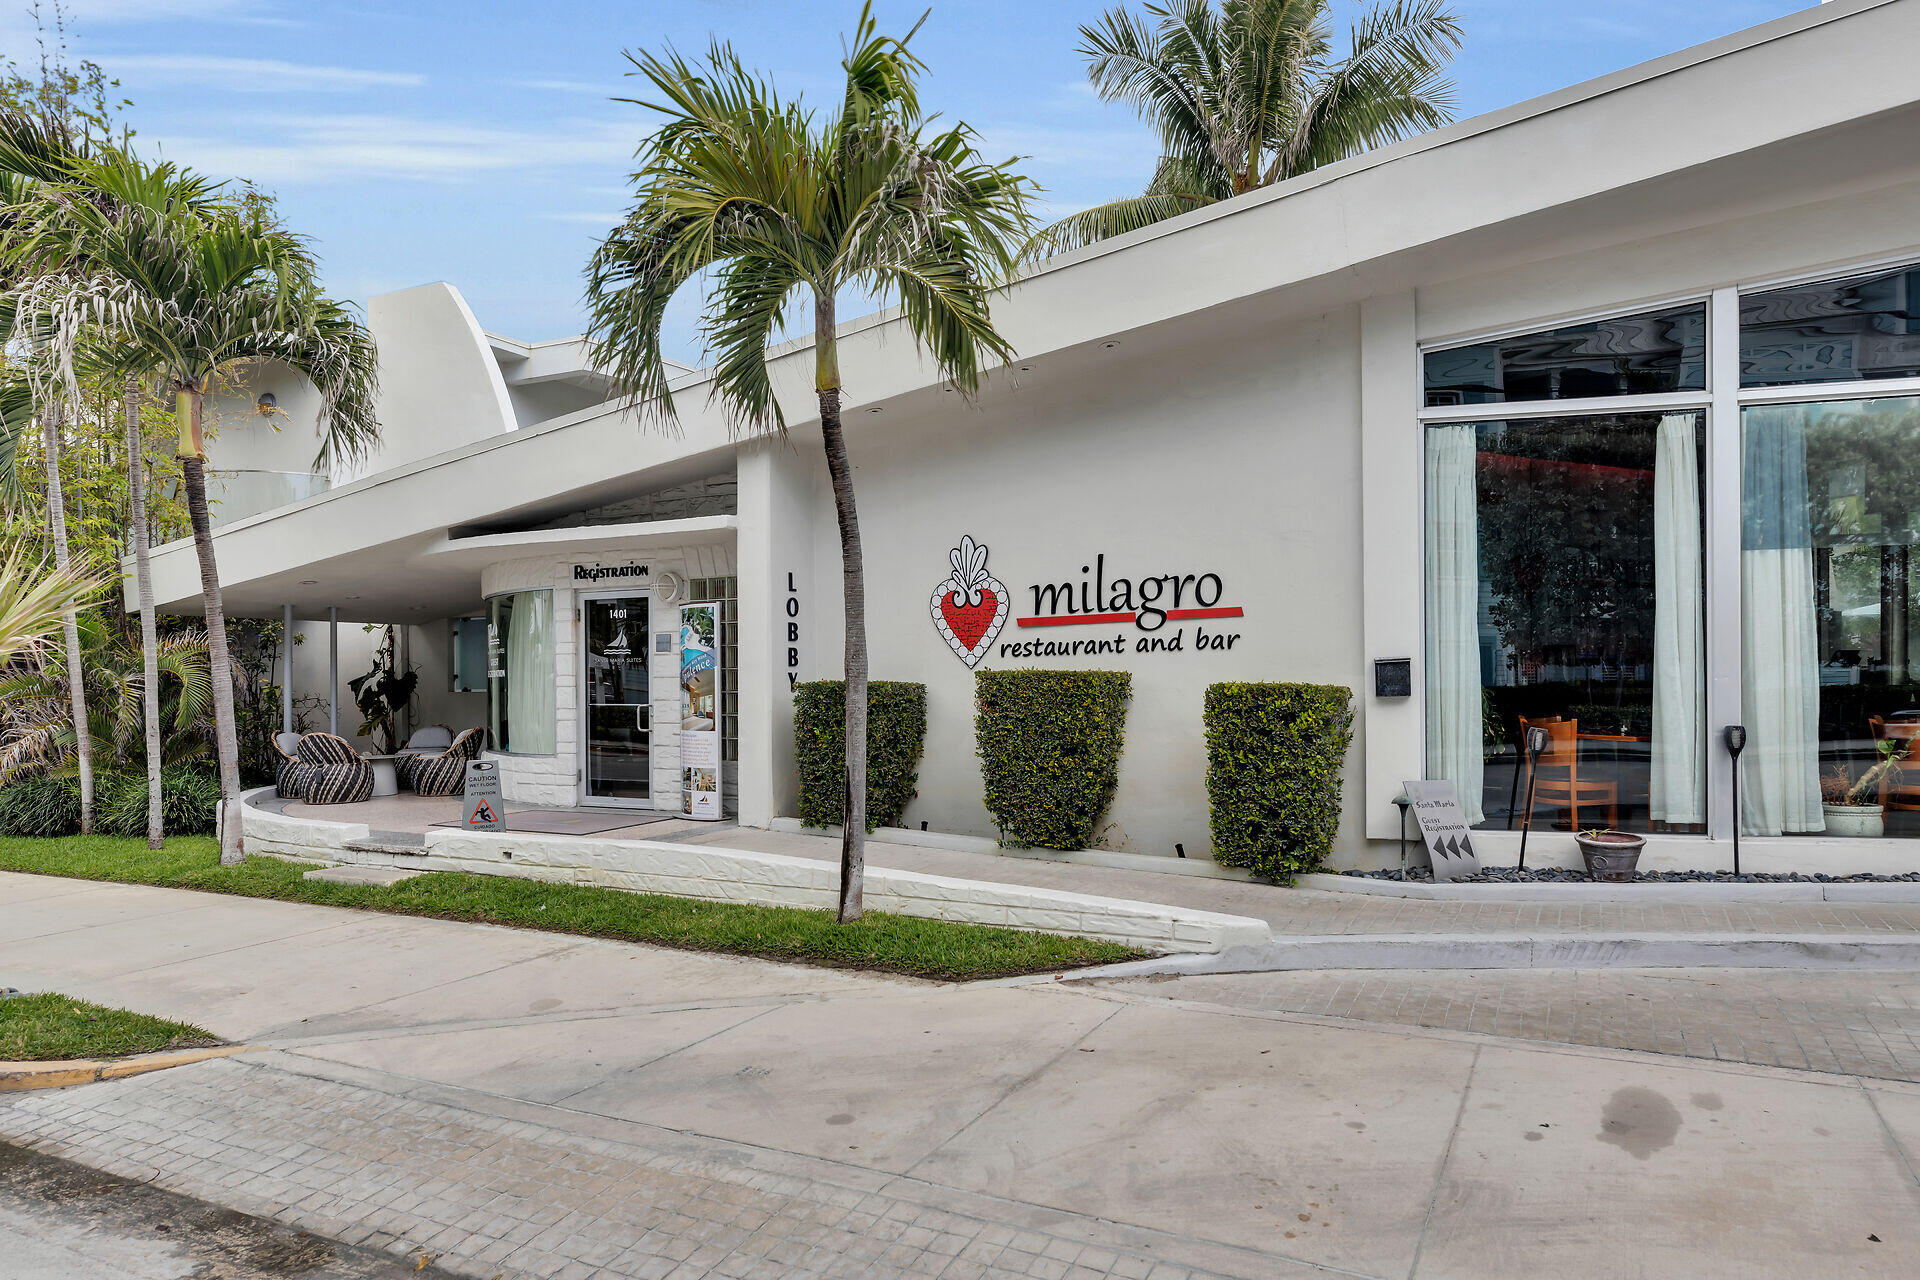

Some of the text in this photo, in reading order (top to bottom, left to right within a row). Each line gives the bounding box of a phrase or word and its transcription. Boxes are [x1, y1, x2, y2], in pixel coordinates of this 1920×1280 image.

[1028, 553, 1223, 631] milagro
[609, 609, 627, 619] 1401
[786, 571, 799, 693] LOBBY
[1000, 626, 1241, 658] restaurant and bar
[1416, 800, 1455, 809] Santa Maria
